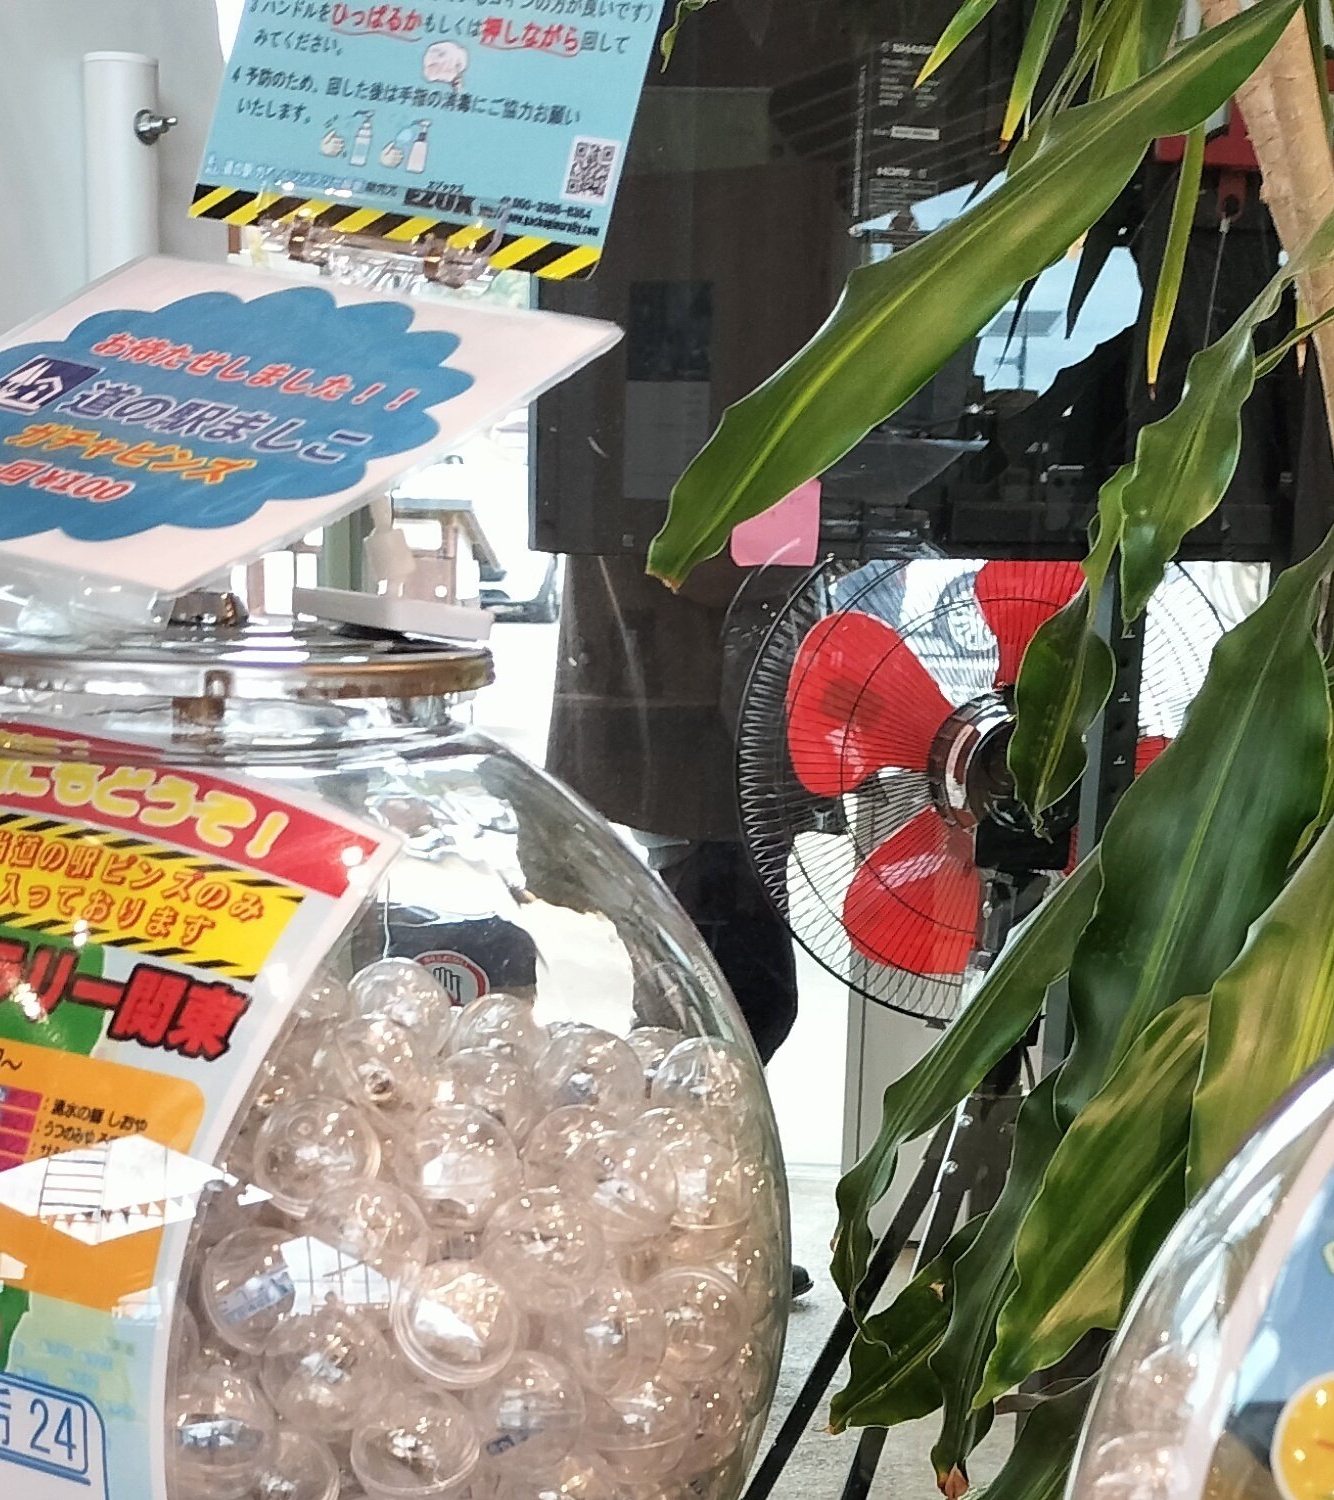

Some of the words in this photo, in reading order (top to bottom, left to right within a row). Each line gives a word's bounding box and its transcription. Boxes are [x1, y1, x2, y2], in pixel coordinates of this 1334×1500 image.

[253, 28, 342, 56] みてください。
[237, 98, 311, 124] いたします。
[89, 332, 420, 411] お待たせしました！！
[53, 379, 373, 464] 道の駅ましこ
[4, 423, 257, 486] ガチャピンズ
[29, 1399, 77, 1462] 24
